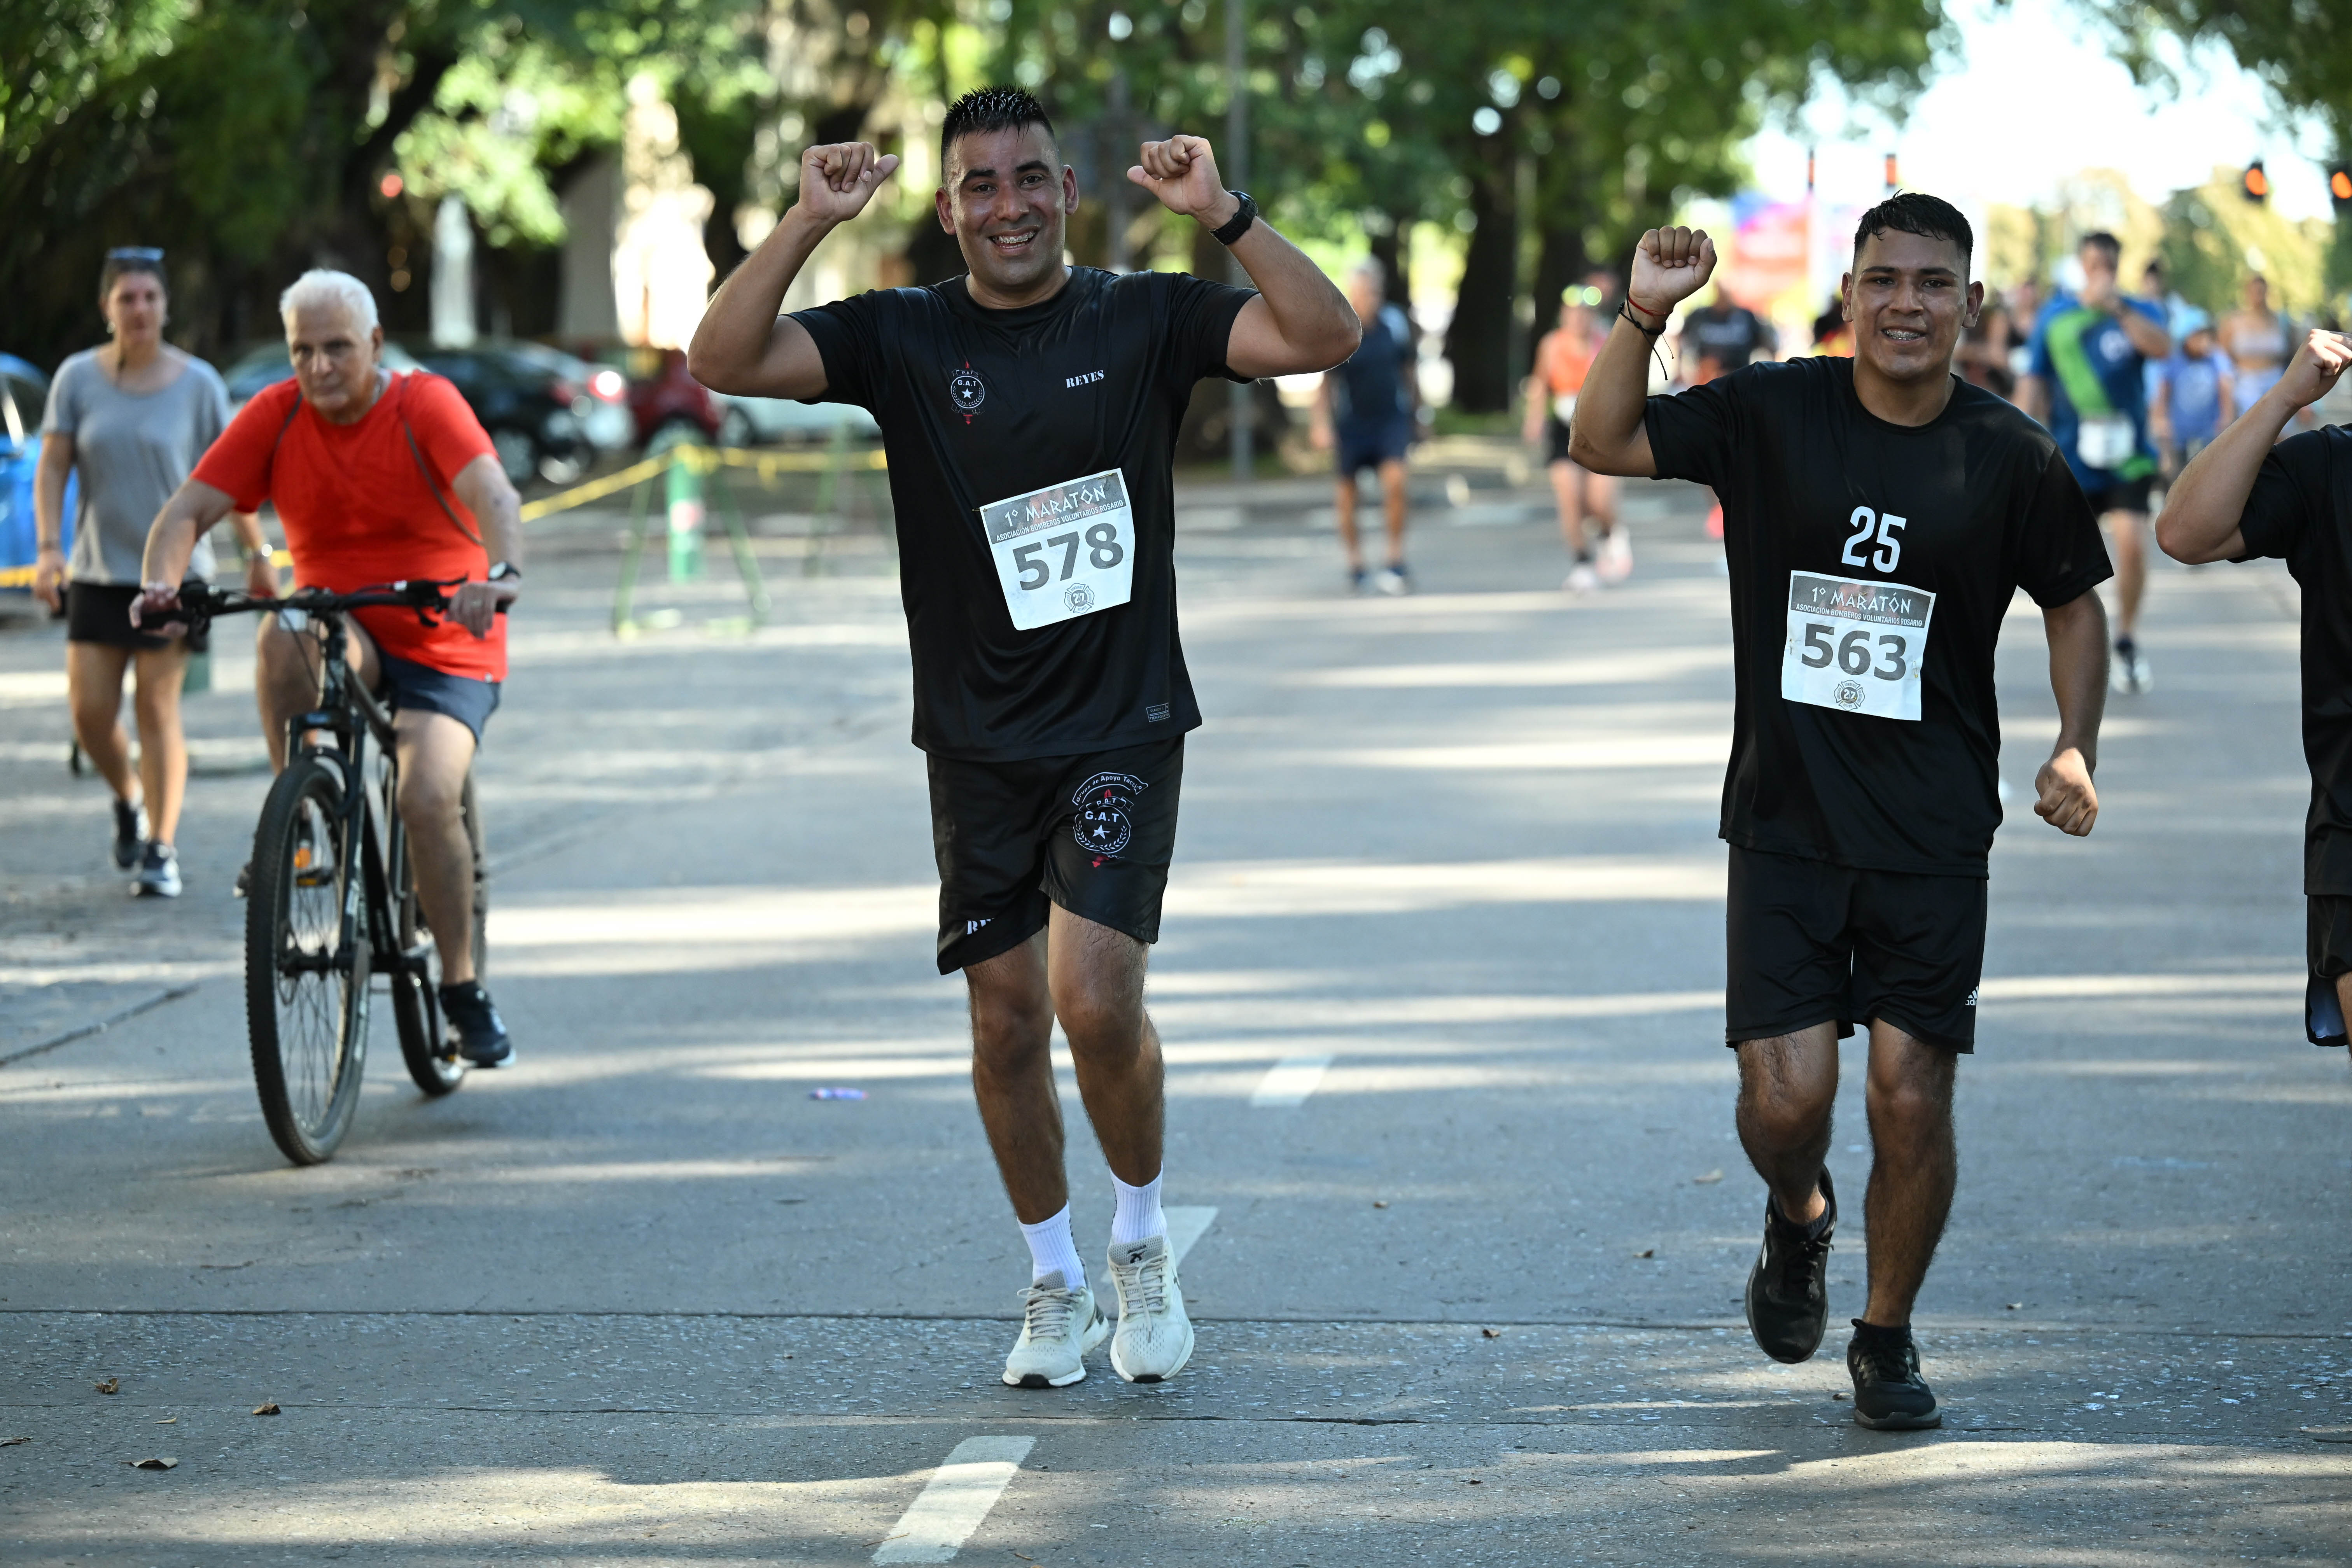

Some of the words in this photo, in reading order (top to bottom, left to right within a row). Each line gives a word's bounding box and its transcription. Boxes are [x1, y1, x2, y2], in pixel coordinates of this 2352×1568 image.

[1066, 369, 1104, 388] REYES
[1026, 484, 1106, 522] MARATÓN
[996, 526, 1030, 542] ASOCIACIÓN
[1030, 517, 1061, 532] BOMBEROS
[1061, 507, 1099, 522] VOLUNTARIOS
[1099, 499, 1124, 512] ROSARIO
[1841, 506, 1907, 573] 25
[1012, 523, 1124, 591] 578
[1073, 593, 1085, 604] 27
[1830, 590, 1911, 614] MARATÓN
[1796, 603, 1829, 615] ASOCIACIÓN
[1831, 609, 1861, 620] BOMBEROS
[1863, 614, 1900, 624] VOLUNTARIOS
[1900, 618, 1923, 627] ROSARIO
[1801, 623, 1906, 681] 563
[1844, 689, 1856, 700] 27
[1076, 785, 1091, 802] Grupo
[1085, 810, 1120, 822] G.A.T
